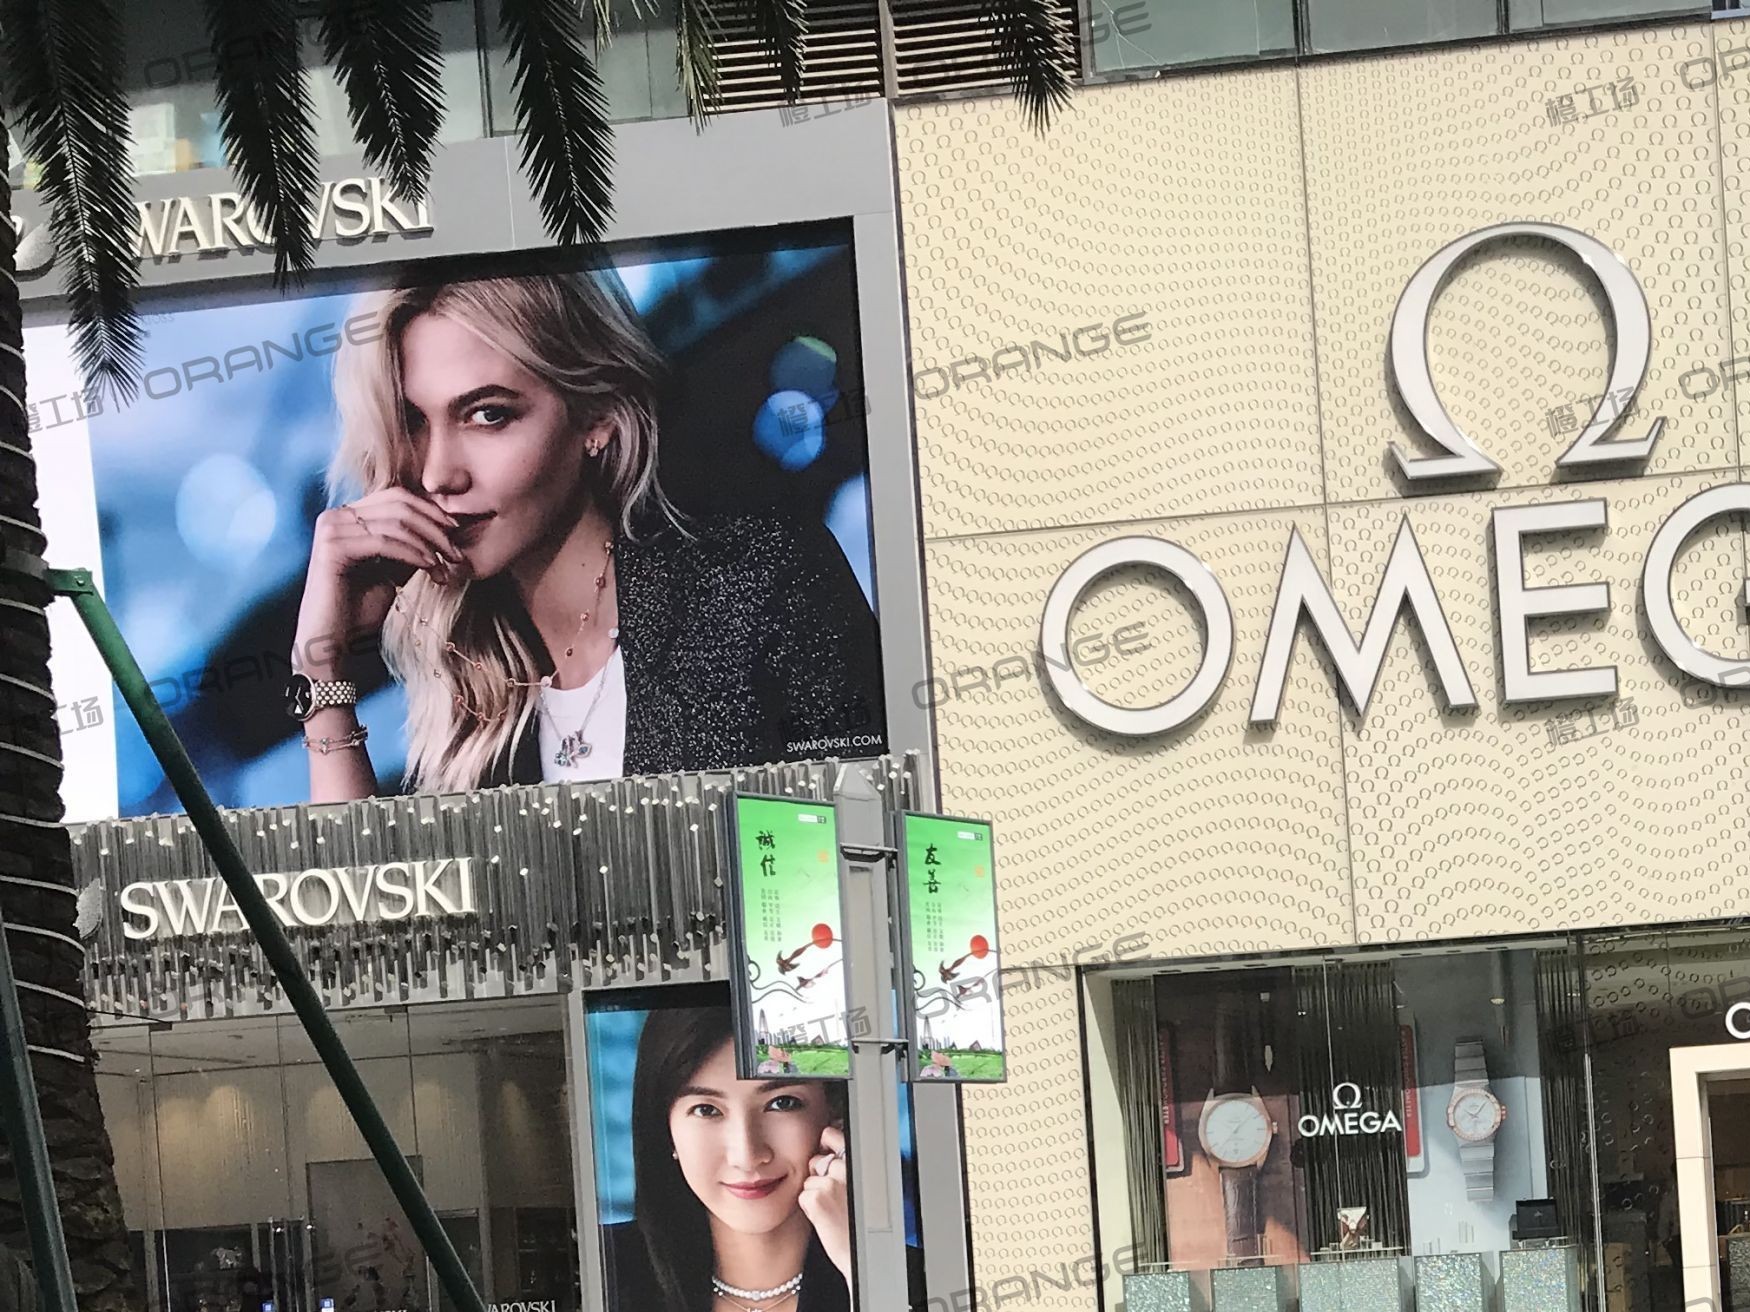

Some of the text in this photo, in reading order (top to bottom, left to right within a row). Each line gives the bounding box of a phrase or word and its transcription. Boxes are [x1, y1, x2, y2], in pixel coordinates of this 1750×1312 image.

[786, 734, 883, 753] SWAROVSKI.COM
[120, 856, 477, 940] SWAROVSKI
[1298, 1110, 1403, 1138] OMEGA
